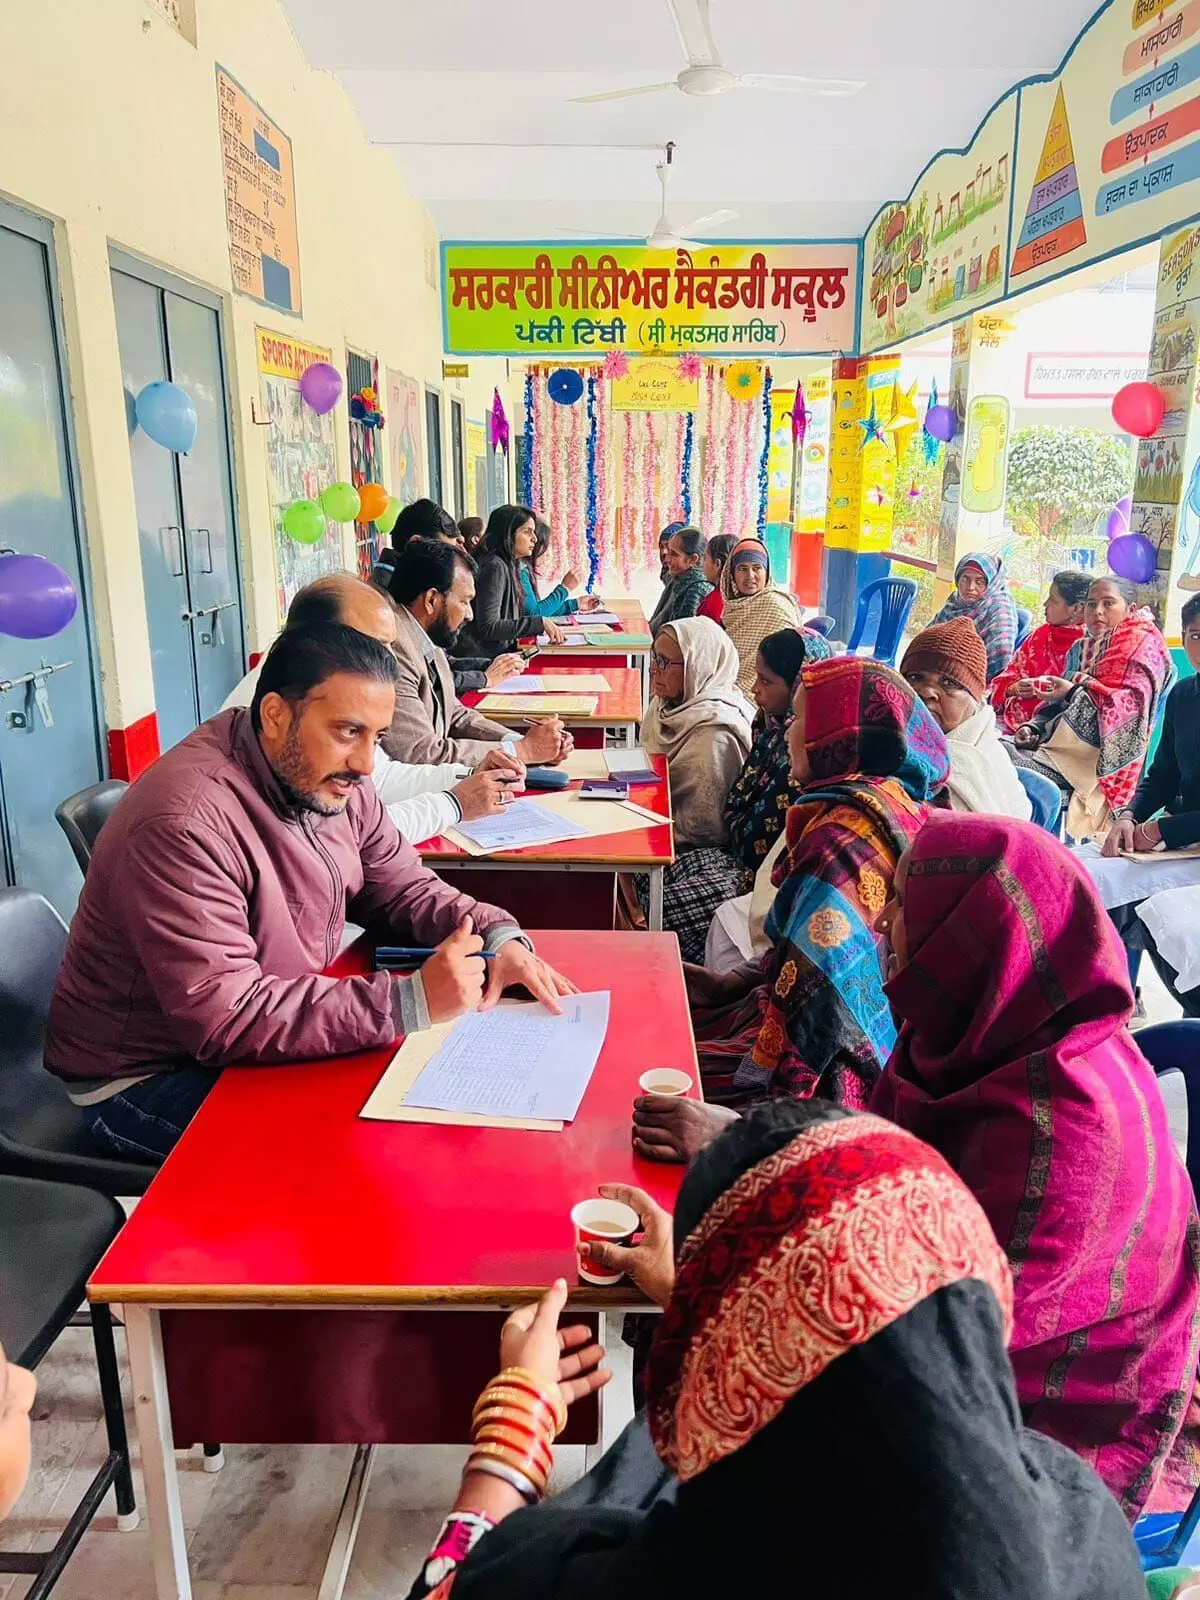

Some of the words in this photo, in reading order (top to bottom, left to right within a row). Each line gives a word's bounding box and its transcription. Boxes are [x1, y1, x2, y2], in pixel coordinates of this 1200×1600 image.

[1141, 12, 1184, 56] ਮਾਸਾਹਾਰੀ
[1105, 185, 1126, 212] ਸੂਰਜ
[1128, 179, 1139, 196] ਦਾ
[1162, 228, 1200, 282] SEASONS
[449, 254, 554, 310] ਸਰਕਾਰੀ
[557, 255, 671, 310] ਸੀਨੀਅਰ
[674, 248, 768, 309] ਸੈਕੰਡਰੀ
[771, 267, 849, 323] ਸਕੂਲ
[515, 315, 565, 343] ਪੱਕੀ
[571, 316, 627, 345] ਟਿੱਬੀ
[670, 324, 730, 347] ਮੁਕਤਸਰ
[262, 335, 293, 370] SPORTS
